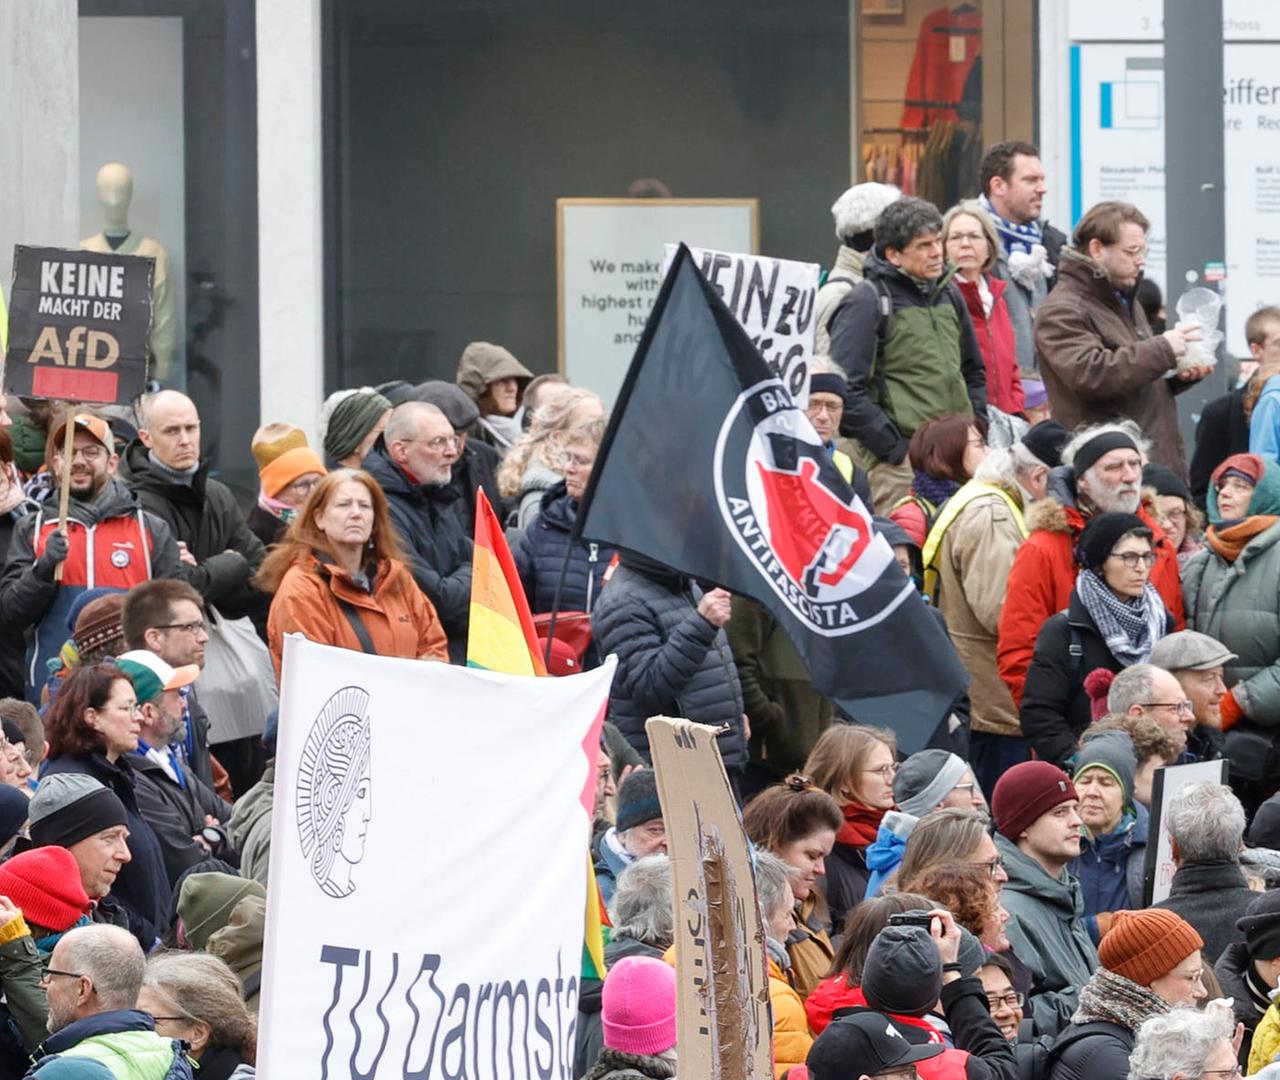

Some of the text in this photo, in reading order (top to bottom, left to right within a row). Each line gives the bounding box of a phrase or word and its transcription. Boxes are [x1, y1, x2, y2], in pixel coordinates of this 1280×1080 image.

[40, 260, 126, 299] KEINE
[590, 260, 616, 273] We
[38, 296, 123, 321] MACHT DER
[582, 294, 643, 312] highest
[775, 286, 816, 335] ZU
[27, 325, 121, 370] AfD
[728, 496, 859, 627] ANTIFASCISTA
